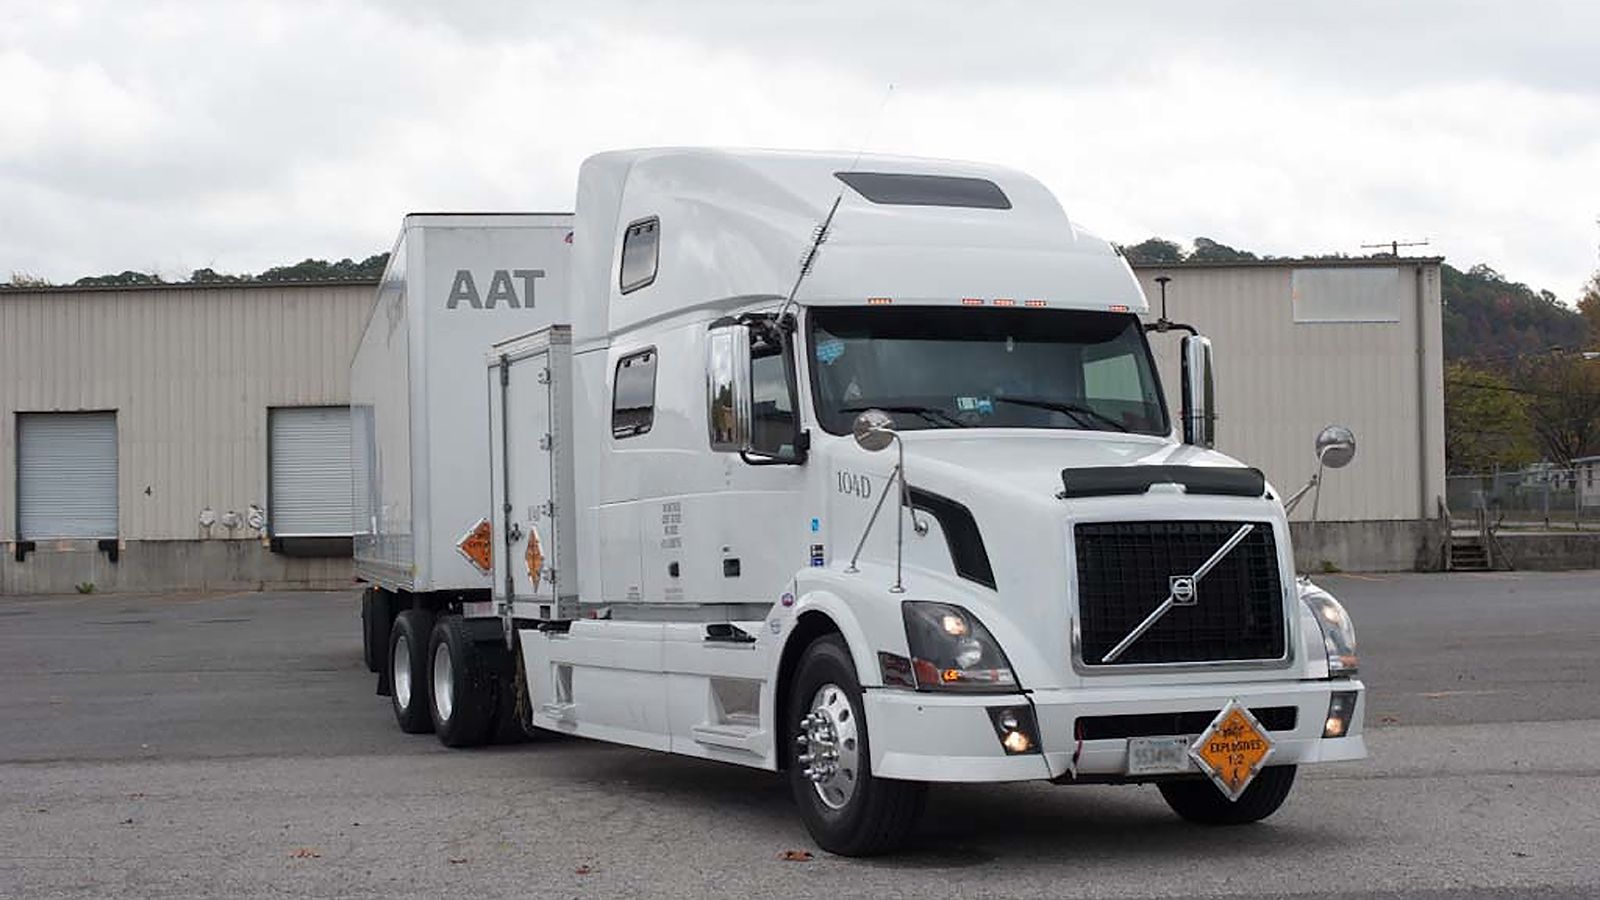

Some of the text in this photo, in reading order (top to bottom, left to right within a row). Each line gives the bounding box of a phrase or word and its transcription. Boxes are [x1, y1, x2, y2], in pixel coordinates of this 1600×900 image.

[446, 269, 545, 309] AAT
[838, 471, 871, 498] 104D
[1210, 740, 1262, 753] EXPLOSIVES
